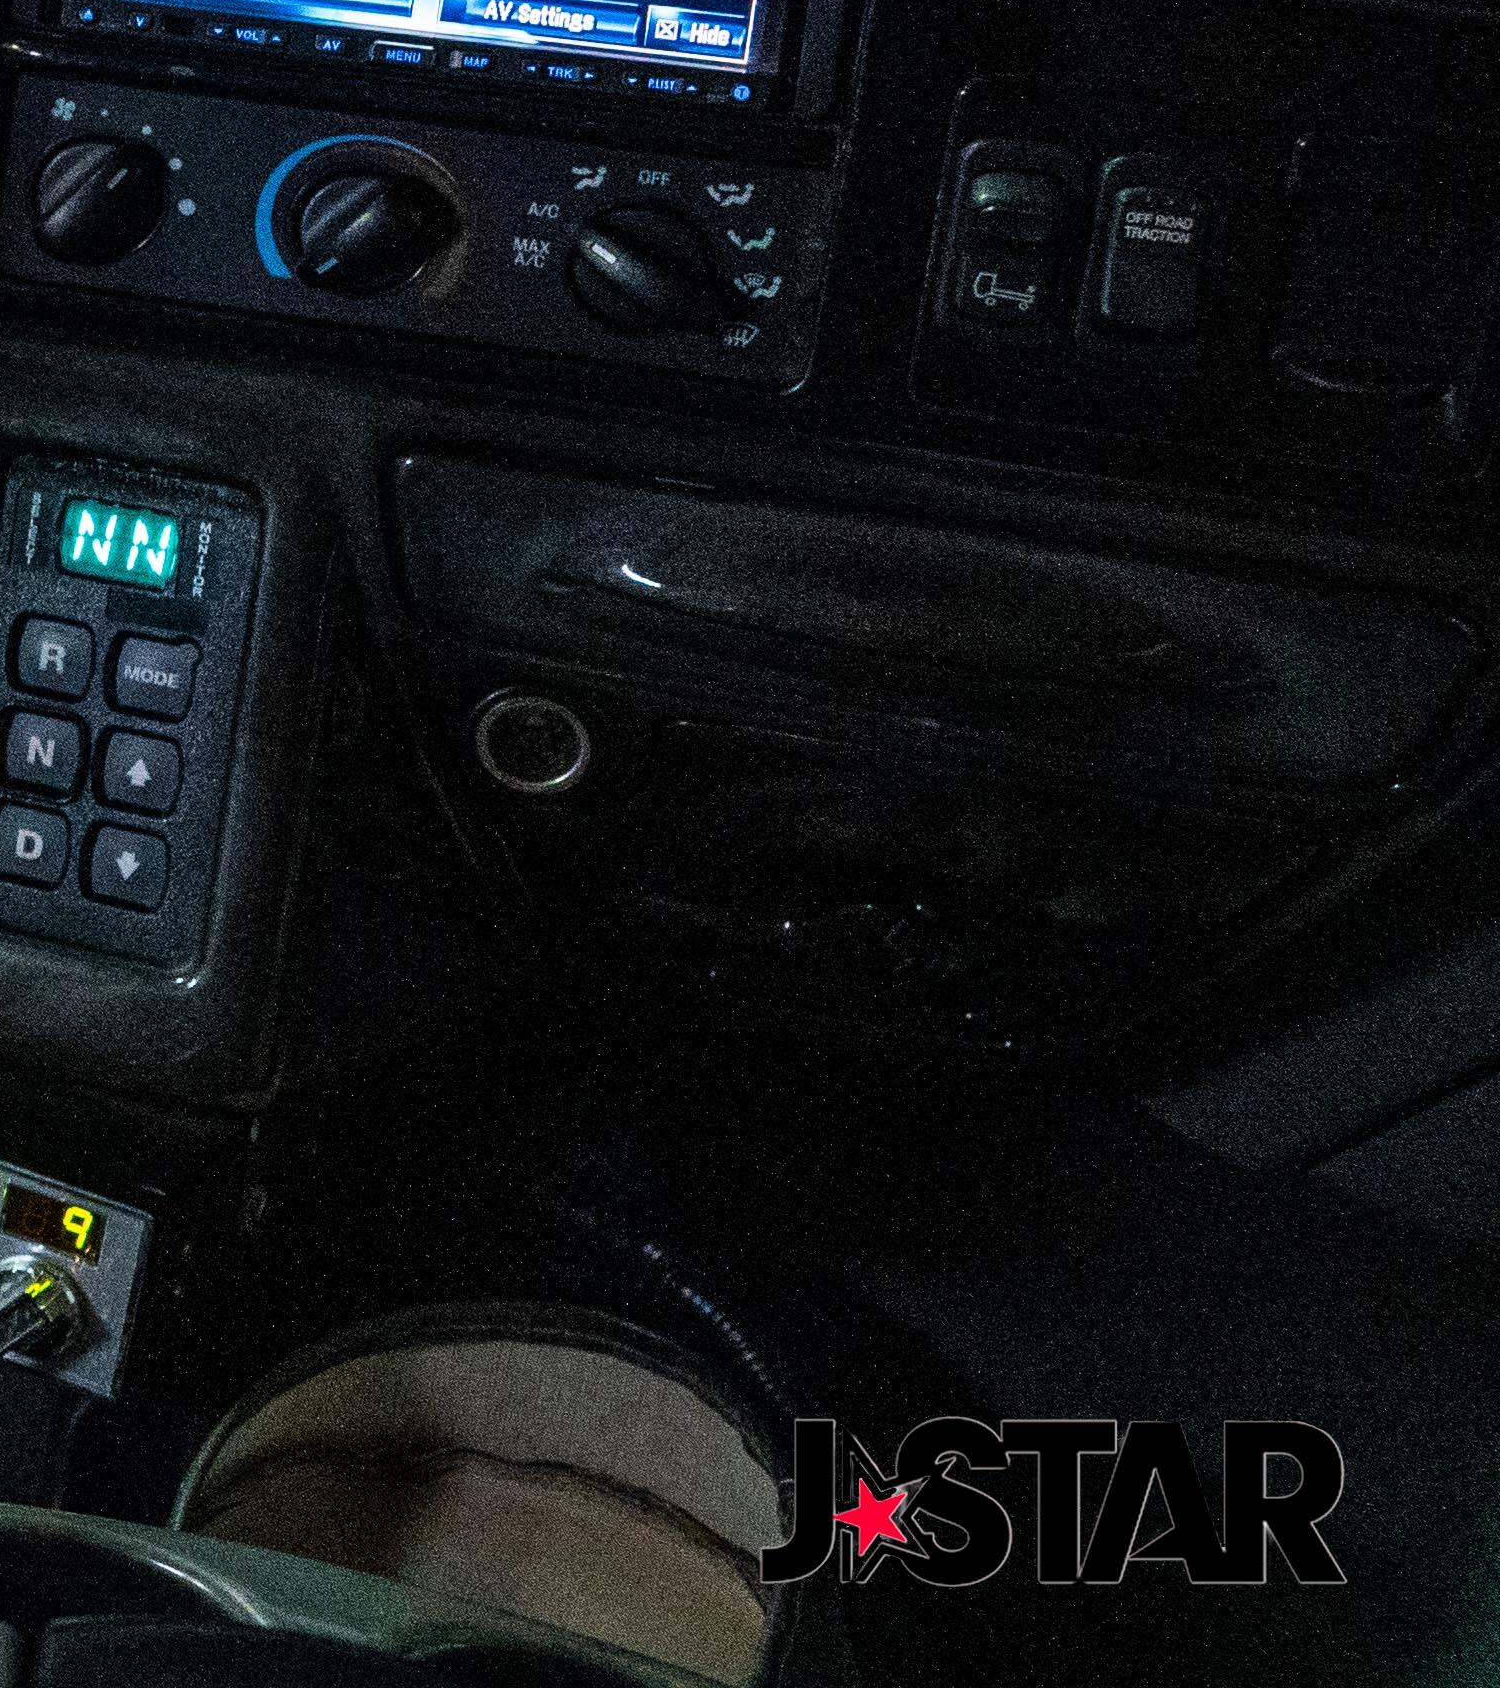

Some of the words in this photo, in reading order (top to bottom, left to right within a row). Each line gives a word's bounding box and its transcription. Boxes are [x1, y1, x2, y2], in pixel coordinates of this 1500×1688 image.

[484, 0, 512, 21] AV
[517, 4, 595, 32] Settings
[236, 29, 259, 41] VOL
[690, 22, 732, 46] Hide
[323, 40, 340, 51] AV
[386, 50, 421, 63] MENU
[464, 57, 489, 69] MAP
[548, 67, 574, 79] TRK
[639, 169, 671, 188] OFF
[528, 202, 559, 219] A/C
[1125, 211, 1151, 227] OFF
[1154, 214, 1193, 231] ROAD
[1123, 226, 1190, 244] TRACTION
[513, 238, 550, 255] MAX
[514, 251, 546, 269] A/C
[192, 521, 212, 598] MONITOR
[39, 642, 66, 674] R
[123, 666, 180, 689] MODE
[26, 737, 56, 768] N
[15, 829, 44, 861] D
[63, 1206, 93, 1249] 9
